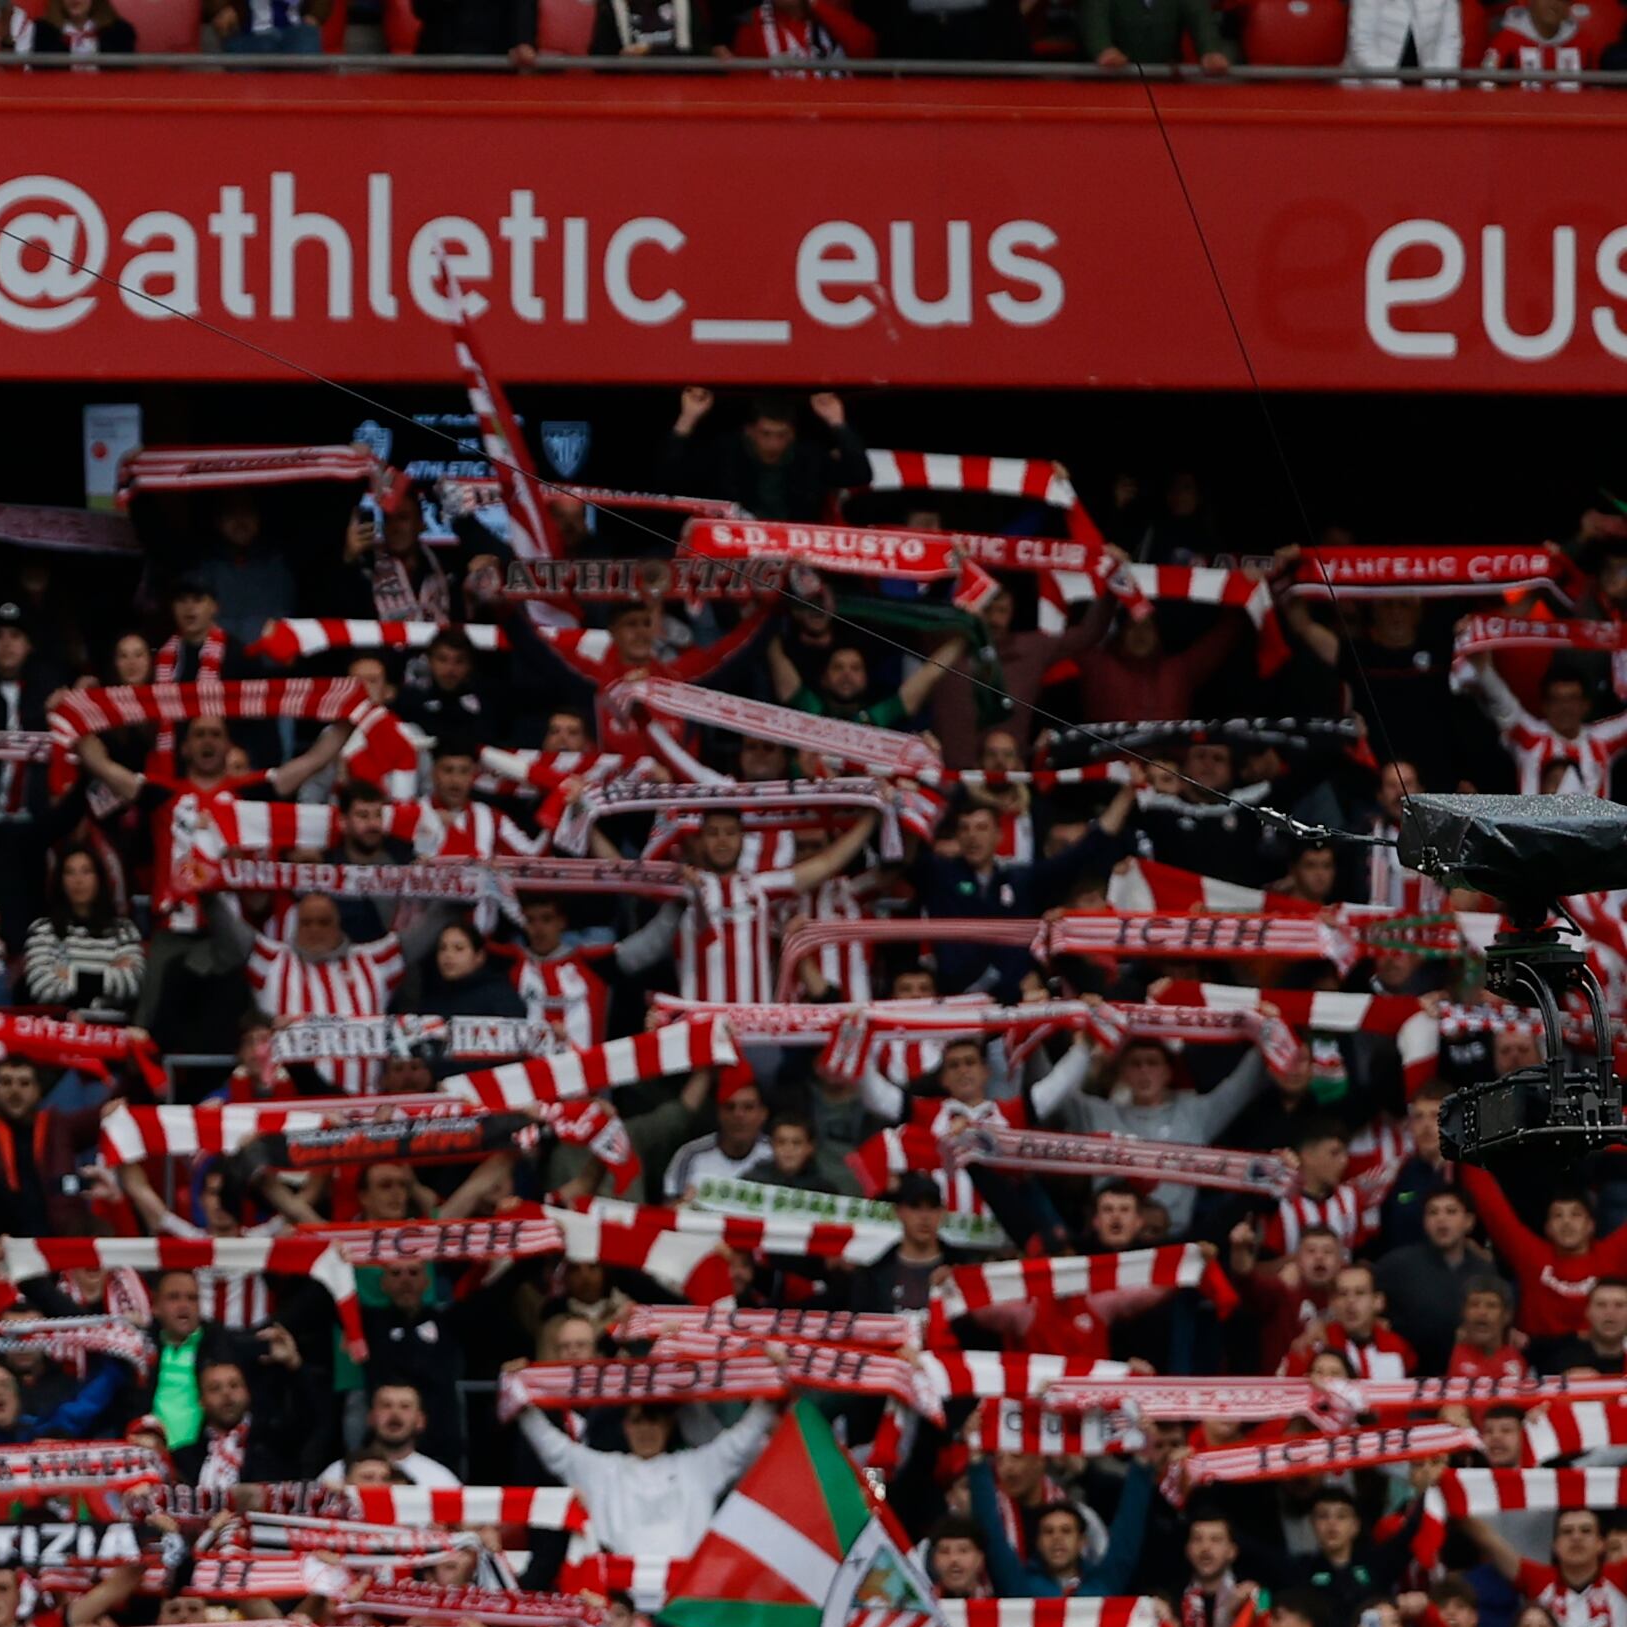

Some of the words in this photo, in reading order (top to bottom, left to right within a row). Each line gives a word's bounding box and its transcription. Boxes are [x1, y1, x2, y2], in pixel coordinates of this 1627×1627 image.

[788, 529, 925, 559] DEUSTO
[1014, 540, 1088, 565] CLUB
[222, 860, 338, 889] UNITED
[1115, 916, 1273, 949] ICHH
[368, 1219, 525, 1260] ICHH
[1258, 1423, 1414, 1469] ICHH
